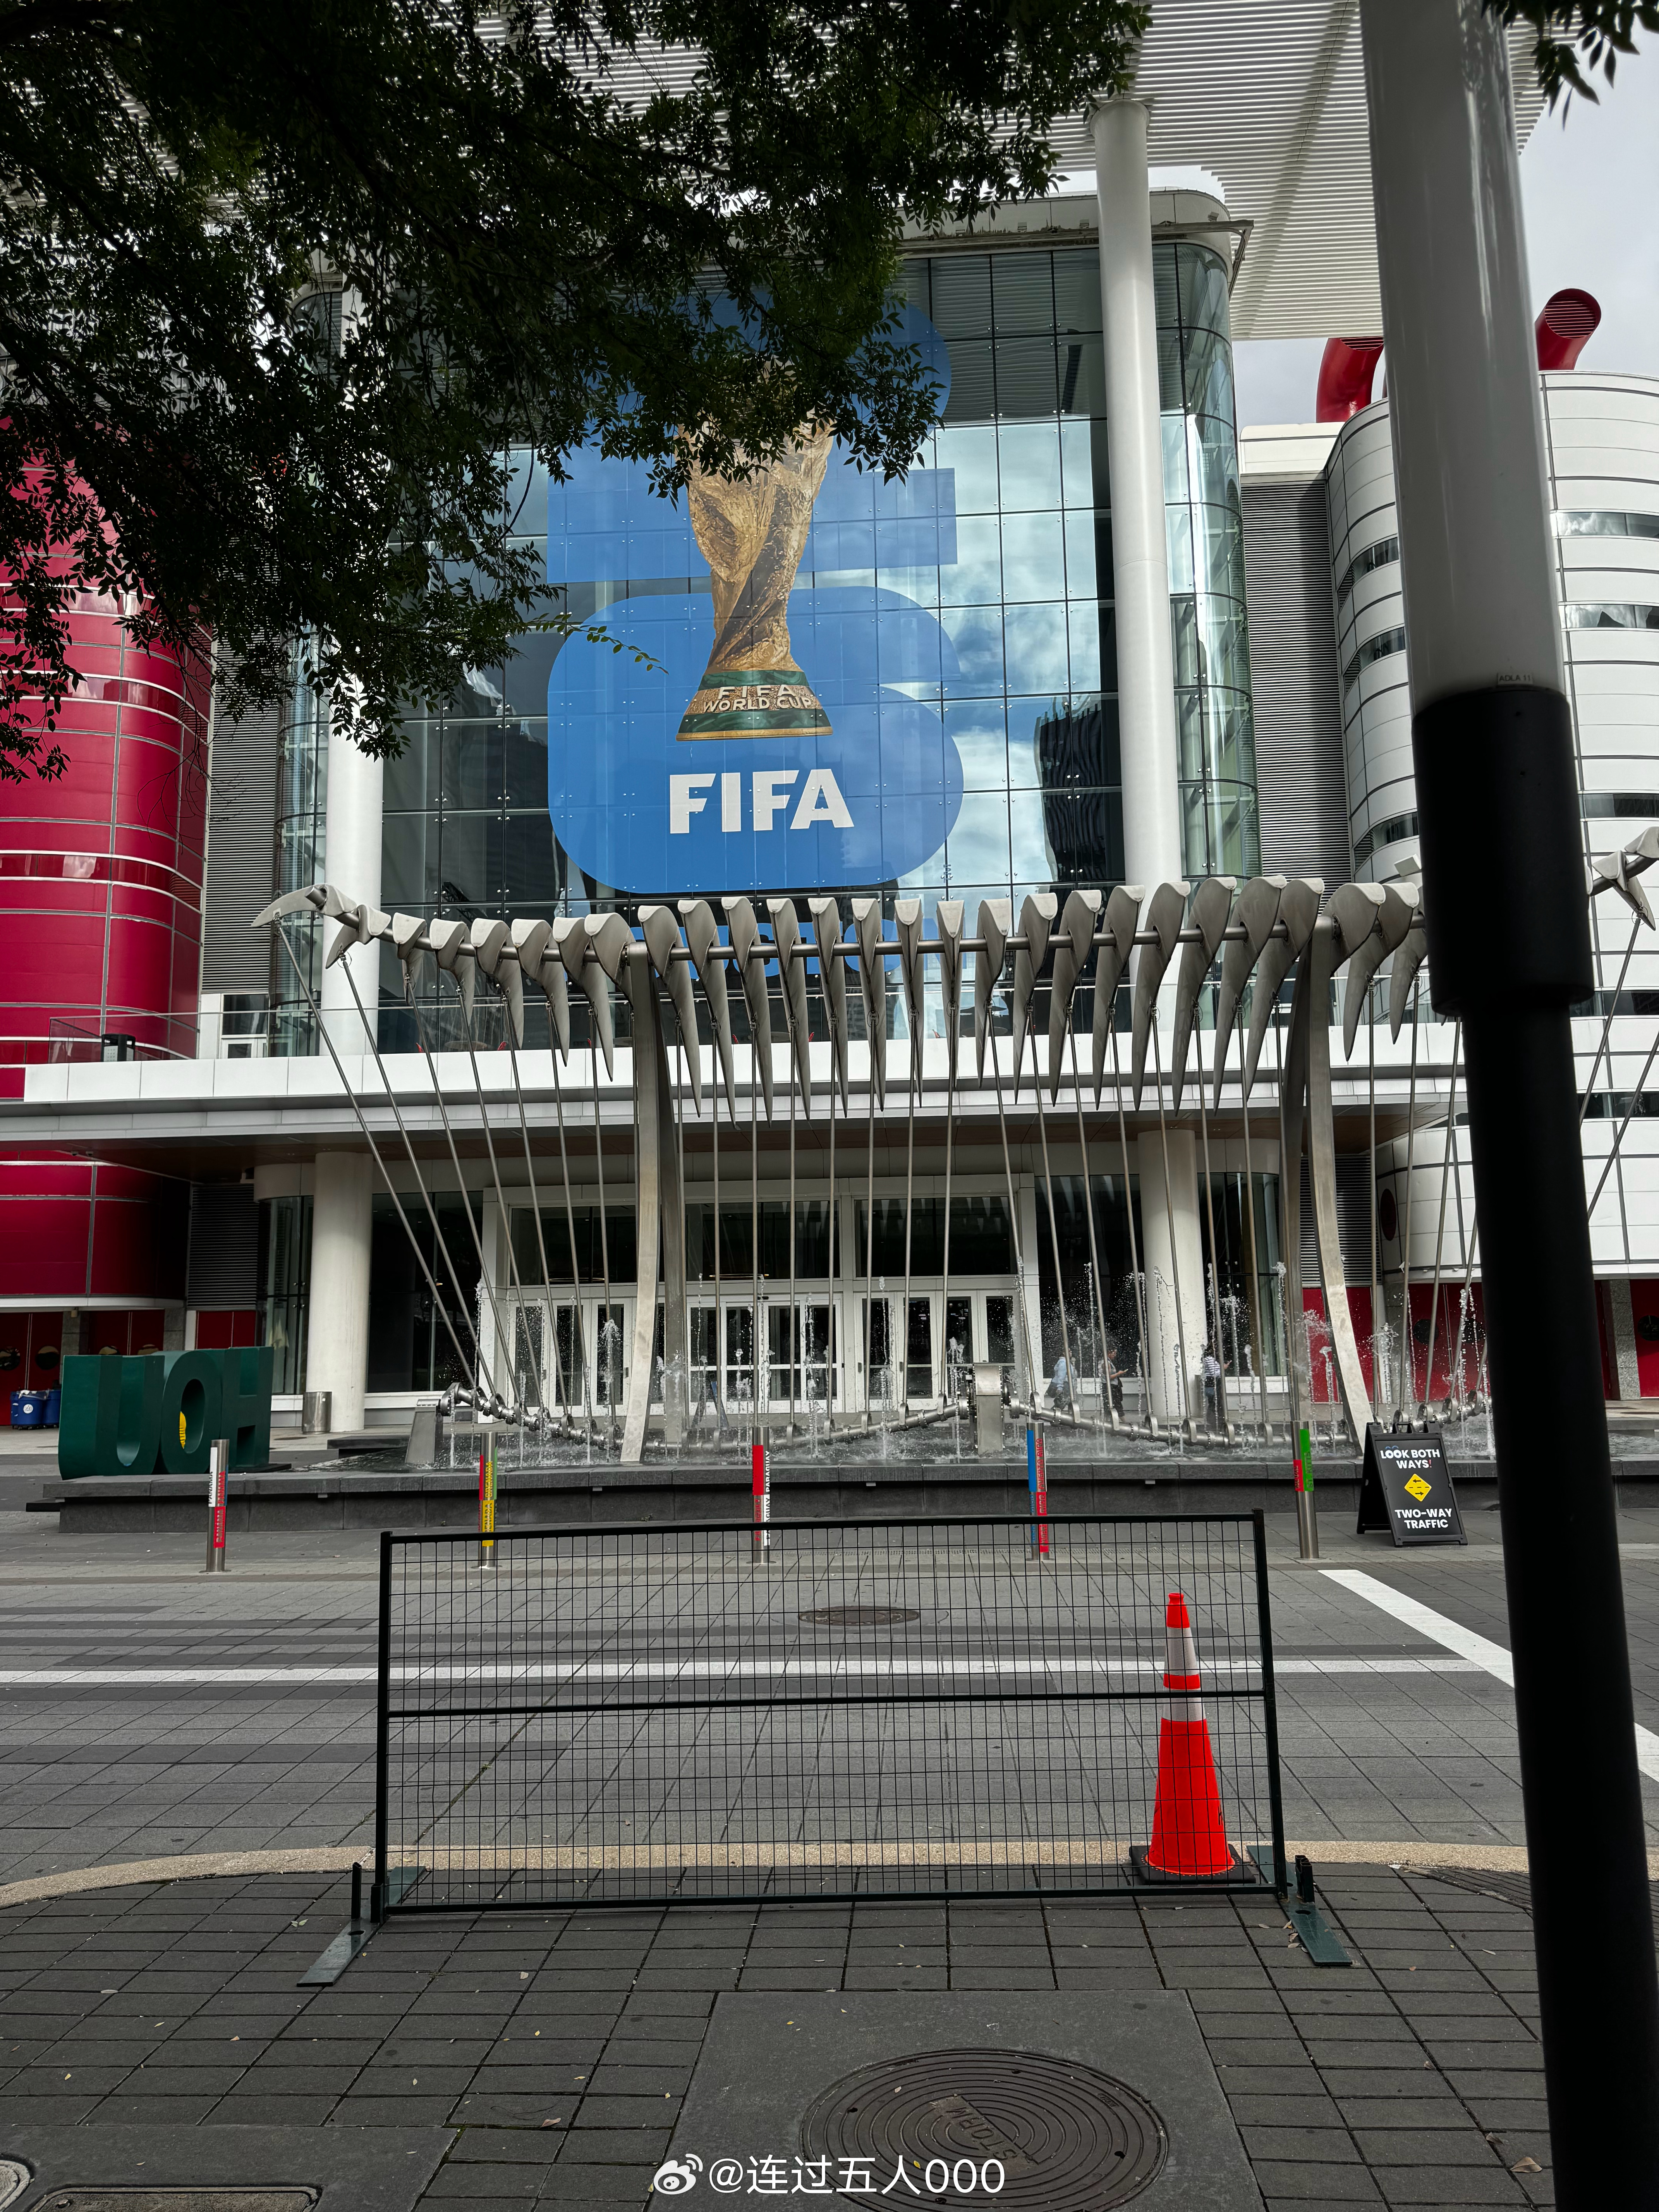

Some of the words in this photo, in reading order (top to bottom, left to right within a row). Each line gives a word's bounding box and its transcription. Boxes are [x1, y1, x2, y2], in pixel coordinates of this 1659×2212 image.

[718, 684, 797, 699] FIFA
[704, 697, 770, 713] WORLD
[776, 697, 813, 709] CUP
[670, 768, 855, 834] FIFA
[1380, 1449, 1410, 1459] LOOK
[1410, 1449, 1441, 1458] BOTH
[1396, 1459, 1432, 1469] WAYS!
[485, 1461, 493, 1498] GRENADA
[484, 1503, 492, 1533] ENADA
[1395, 1508, 1452, 1518] TWO-WAY
[1404, 1519, 1449, 1529] TRAFFIC
